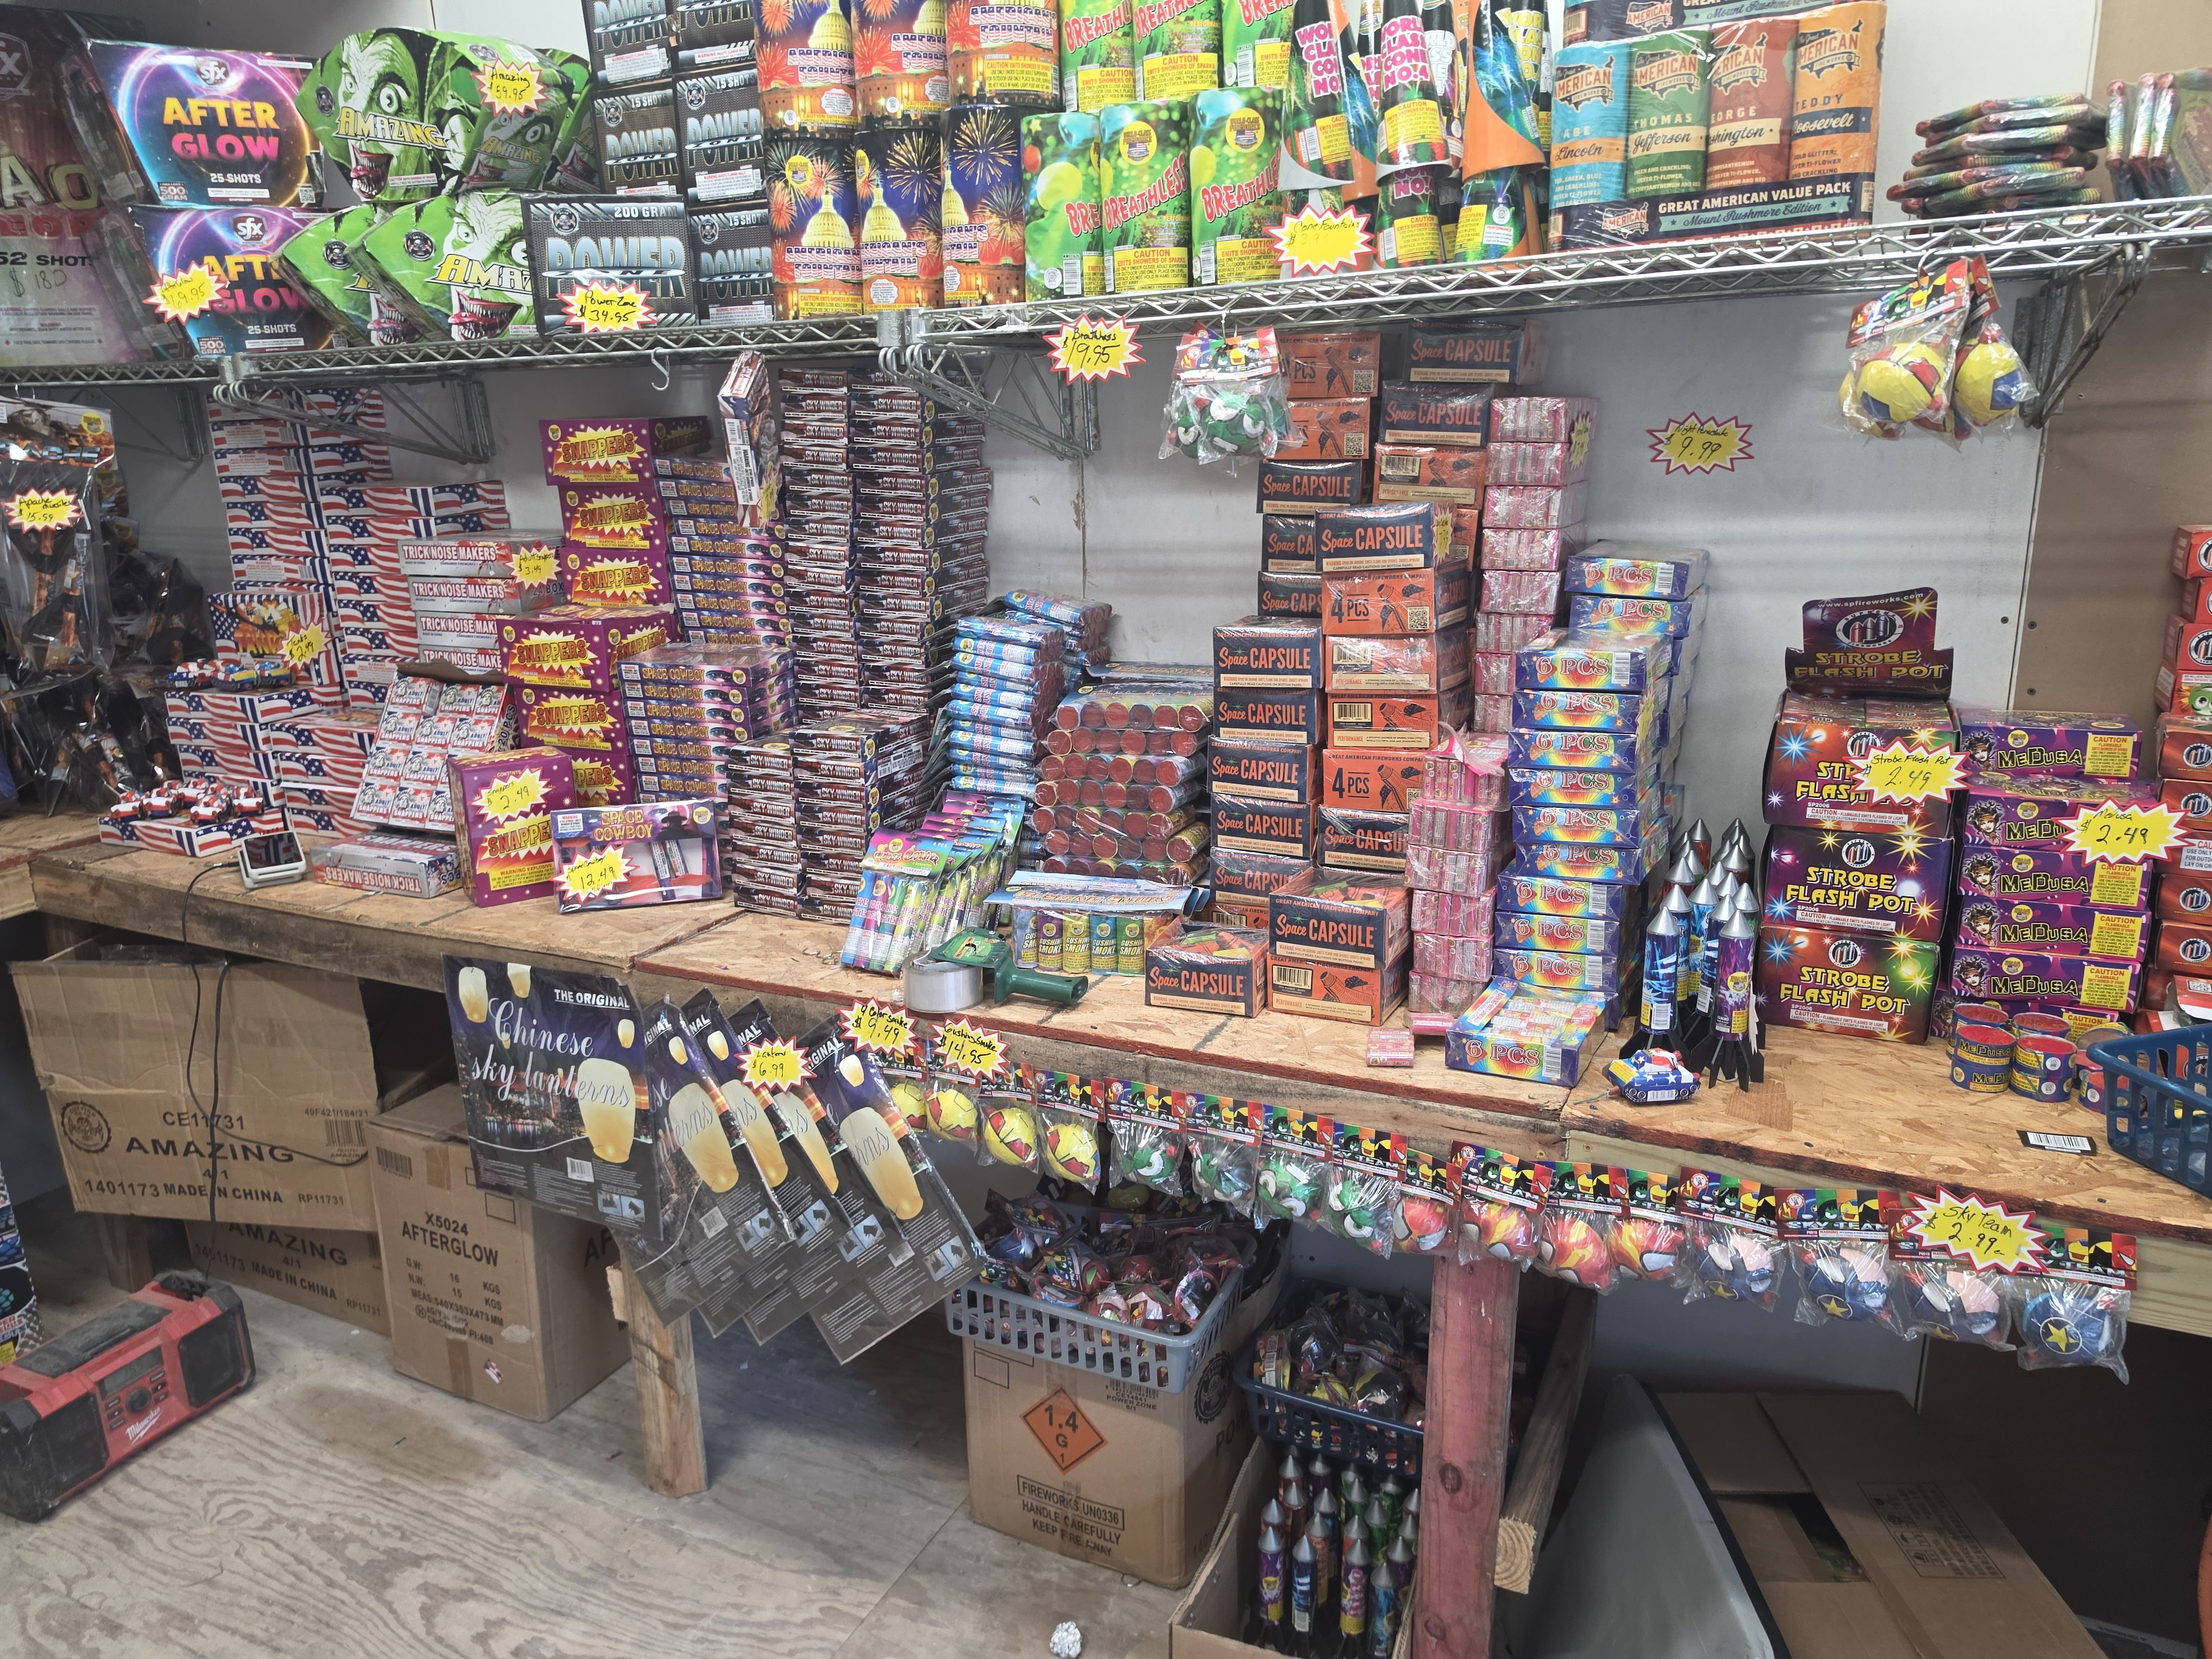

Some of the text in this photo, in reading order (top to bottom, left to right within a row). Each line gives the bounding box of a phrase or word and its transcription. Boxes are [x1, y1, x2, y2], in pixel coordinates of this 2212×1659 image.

[979, 24, 1053, 46] FOUNTAIN
[201, 63, 227, 85] sfx
[491, 66, 529, 90] Amazing
[1147, 70, 1165, 79] EMITS
[1166, 66, 1191, 75] SHOWERS
[1383, 62, 1430, 91] NO.4
[1634, 54, 1697, 86] AMERICAN
[716, 73, 755, 90] 15 SHOTS
[1796, 94, 1843, 110] TEDDY
[163, 97, 279, 129] AFTER
[1634, 113, 1693, 128] THOMAS
[1712, 107, 1757, 124] EORGE
[687, 109, 762, 167] POWER
[693, 137, 757, 148] ZONE
[1563, 127, 1590, 139] ABE
[172, 133, 279, 162] GLOW
[1554, 143, 1603, 161] Lincoln
[1632, 131, 1692, 155] Jefferson
[211, 173, 261, 184] 25 SHOTS
[160, 185, 186, 195] 500
[1104, 152, 1188, 233] BREATHLESS
[1658, 182, 1851, 214] GREAT AMERICAN VALUE PACK
[614, 206, 678, 217] 200 GRAM
[1683, 202, 1822, 228] Mount Rushmore Edition
[1292, 221, 1317, 233] Cone
[1134, 249, 1171, 258] CAUTION
[248, 324, 296, 334] 25 SHOTS
[562, 433, 636, 462] SNAPPERS
[580, 501, 649, 528] SNAPPERS
[691, 540, 745, 554] SPACE COWBOY
[1321, 529, 1354, 551] Space
[1355, 525, 1423, 549] CAPSULE
[403, 546, 496, 560] TRICK NOISE MAKERS
[1585, 564, 1653, 583] 6 PCS
[1331, 591, 1369, 624] 4 PCS
[1818, 592, 1923, 608] www.spfireworks.com
[1219, 646, 1311, 670] Space CAPSULE
[1816, 650, 1921, 664] STROBE
[1536, 658, 1609, 676] 6 PCS
[1794, 665, 1948, 679] FLASH POT
[1332, 768, 1369, 799] 4 PCS
[601, 810, 644, 825] SPACE
[593, 823, 653, 841] COWBOY
[500, 868, 525, 876] WARNING
[1807, 867, 1897, 891] STROBE
[1295, 900, 1319, 909] AMERICAN
[1786, 884, 1916, 914] FLASH POT
[1066, 941, 1090, 953] SMOKE
[555, 989, 630, 1008] THE ORIGINAL
[1276, 999, 1302, 1008] PERFORMANCE
[489, 998, 593, 1057] Chinese
[472, 1045, 630, 1107] sky lanterns
[163, 1111, 244, 1130] CE11731
[1110, 1103, 1180, 1123] SKY TEAM
[126, 1137, 294, 1162] AMAZING
[85, 1179, 284, 1203] 1401173 MADE CHINA
[298, 1193, 344, 1204] RP11731
[425, 1212, 468, 1236] X5024
[1943, 1206, 2012, 1238] Sky Team
[402, 1222, 498, 1266] AFTERGLOW
[450, 1273, 460, 1283] 16
[300, 1280, 337, 1300] CHINA
[483, 1282, 500, 1295] KGS
[1107, 1396, 1132, 1404] POWER
[126, 1407, 162, 1442] Milwaukee
[1044, 1404, 1078, 1433] 1.4
[1056, 1433, 1067, 1448] G
[1060, 1452, 1065, 1463] 1
[1022, 1481, 1119, 1525] FIREWORKS UN0336
[1022, 1500, 1121, 1545] HANDLE CAREFULLY
[1032, 1518, 1057, 1537] KEEP
